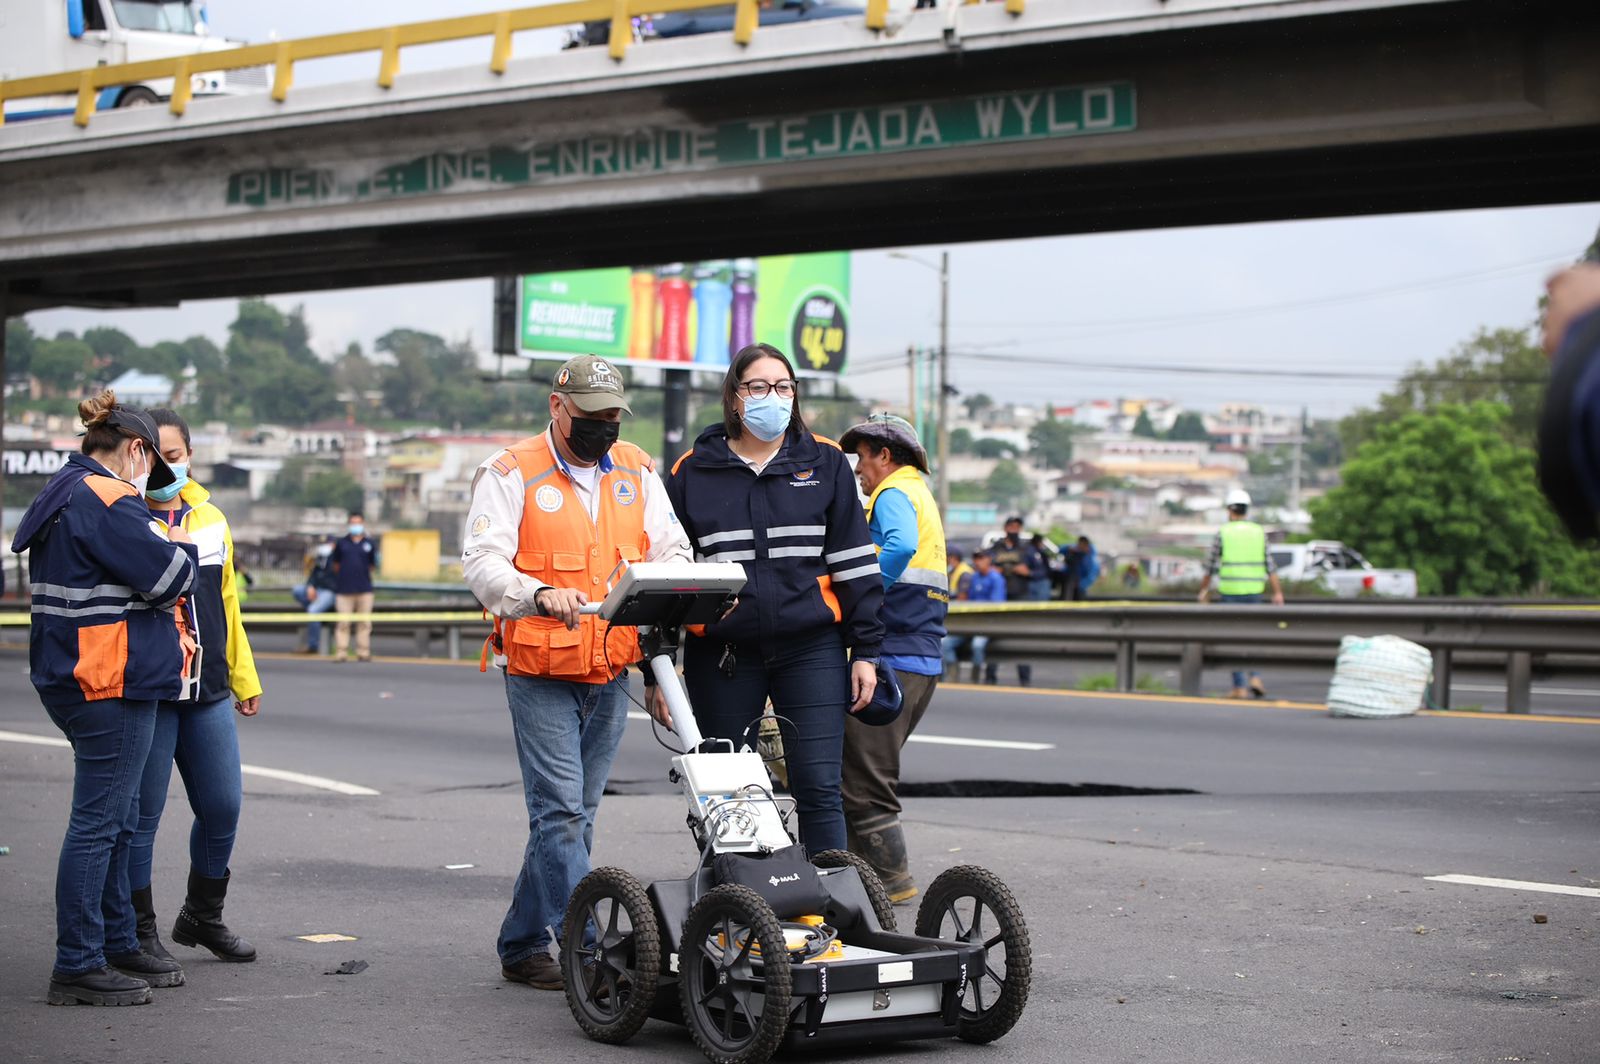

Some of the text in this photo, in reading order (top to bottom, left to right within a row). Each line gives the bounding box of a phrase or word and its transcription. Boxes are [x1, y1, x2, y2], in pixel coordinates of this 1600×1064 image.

[426, 151, 504, 192] ING.
[528, 126, 719, 179] ENRIQUE
[747, 105, 942, 160] TEJADA
